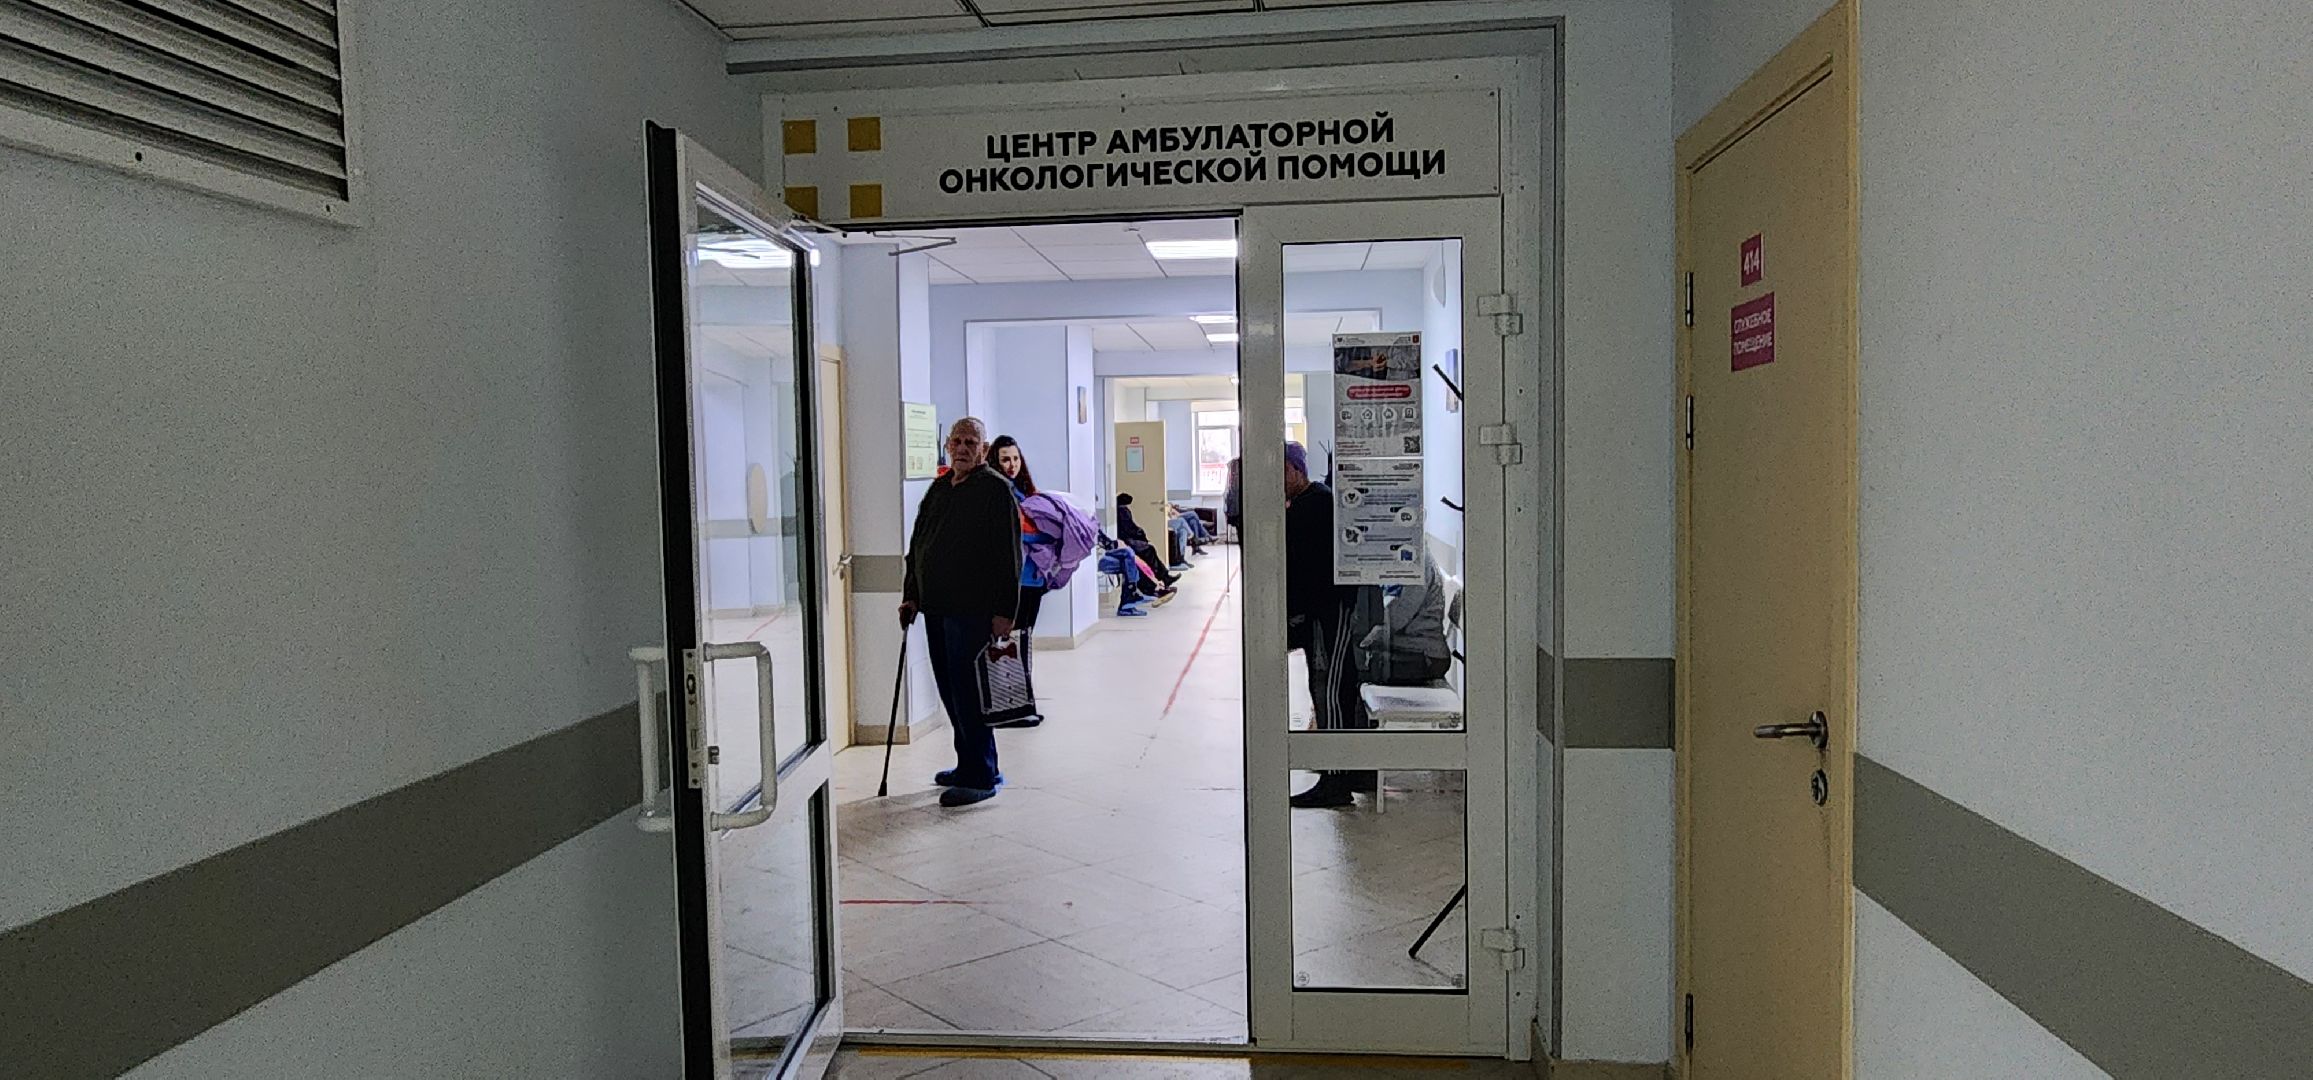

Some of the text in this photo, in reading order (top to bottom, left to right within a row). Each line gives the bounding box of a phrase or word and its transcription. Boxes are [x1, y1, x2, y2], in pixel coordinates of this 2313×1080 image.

[986, 111, 1395, 164] ЦЕНТР АМБУЛАТОРНОЙ
[939, 148, 1446, 193] ОНКОЛОГИЧЕСКОЙ ПОМОЩИ
[1743, 247, 1760, 275] 414
[1733, 308, 1772, 334] СЛУЖЕБНОЕ
[1733, 331, 1773, 355] ПОМЕЩЕНИЕ
